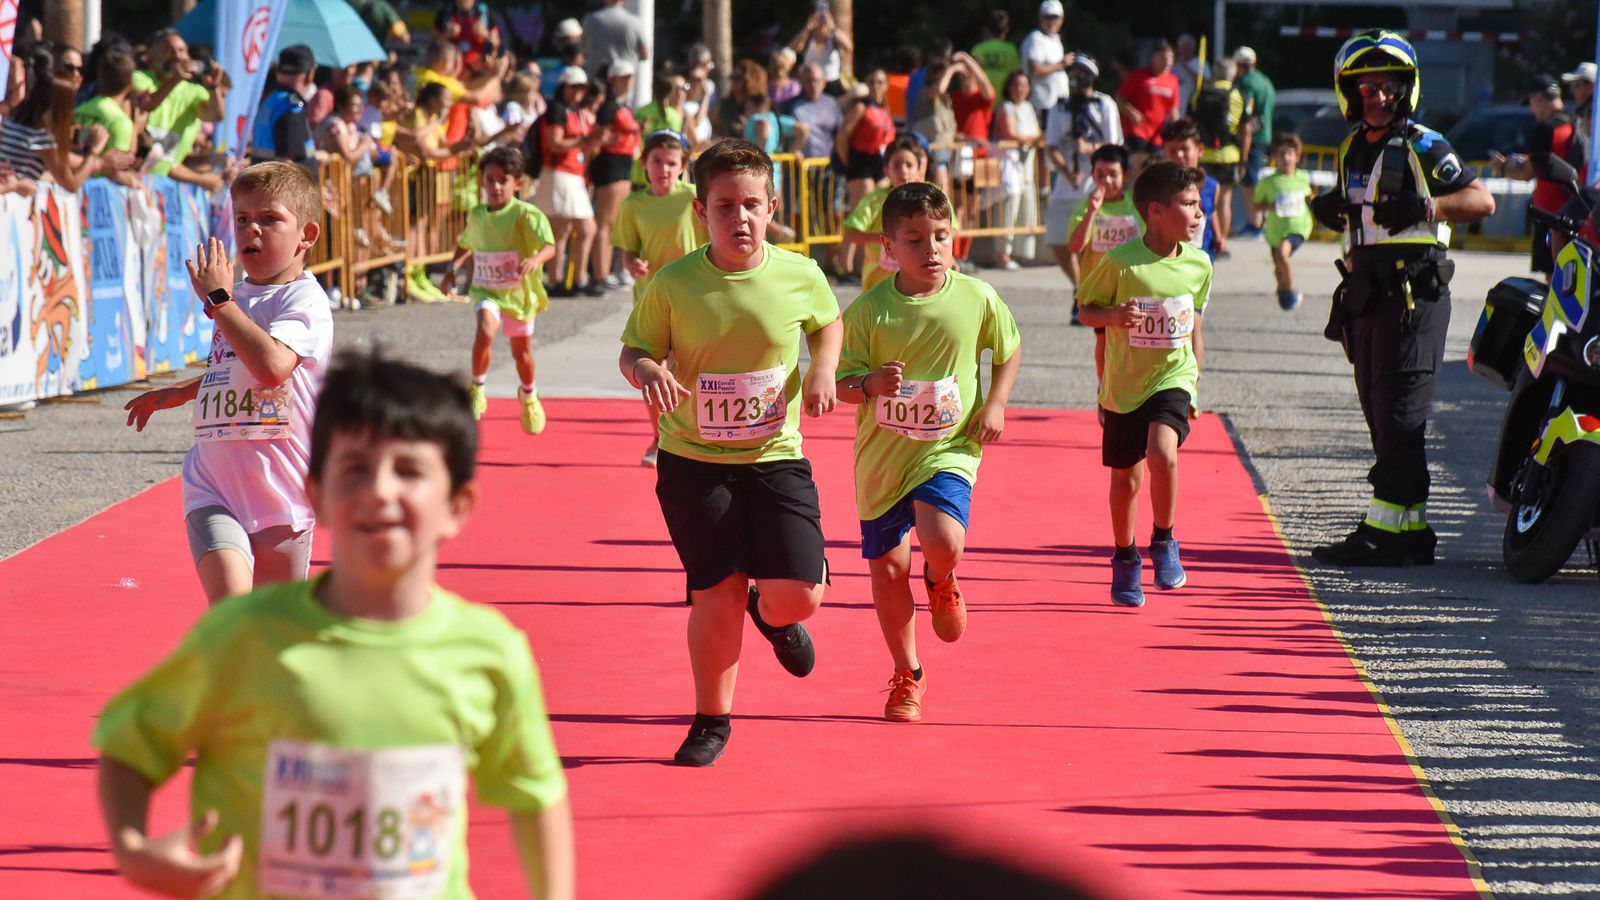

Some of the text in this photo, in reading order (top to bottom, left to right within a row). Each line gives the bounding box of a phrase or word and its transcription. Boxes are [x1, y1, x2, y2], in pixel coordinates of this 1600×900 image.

[1096, 227, 1126, 242] 1425
[700, 379, 717, 390] XXI
[200, 388, 255, 420] 1184
[704, 397, 761, 422] 1123
[883, 400, 936, 425] 1012
[278, 801, 402, 860] 1018
